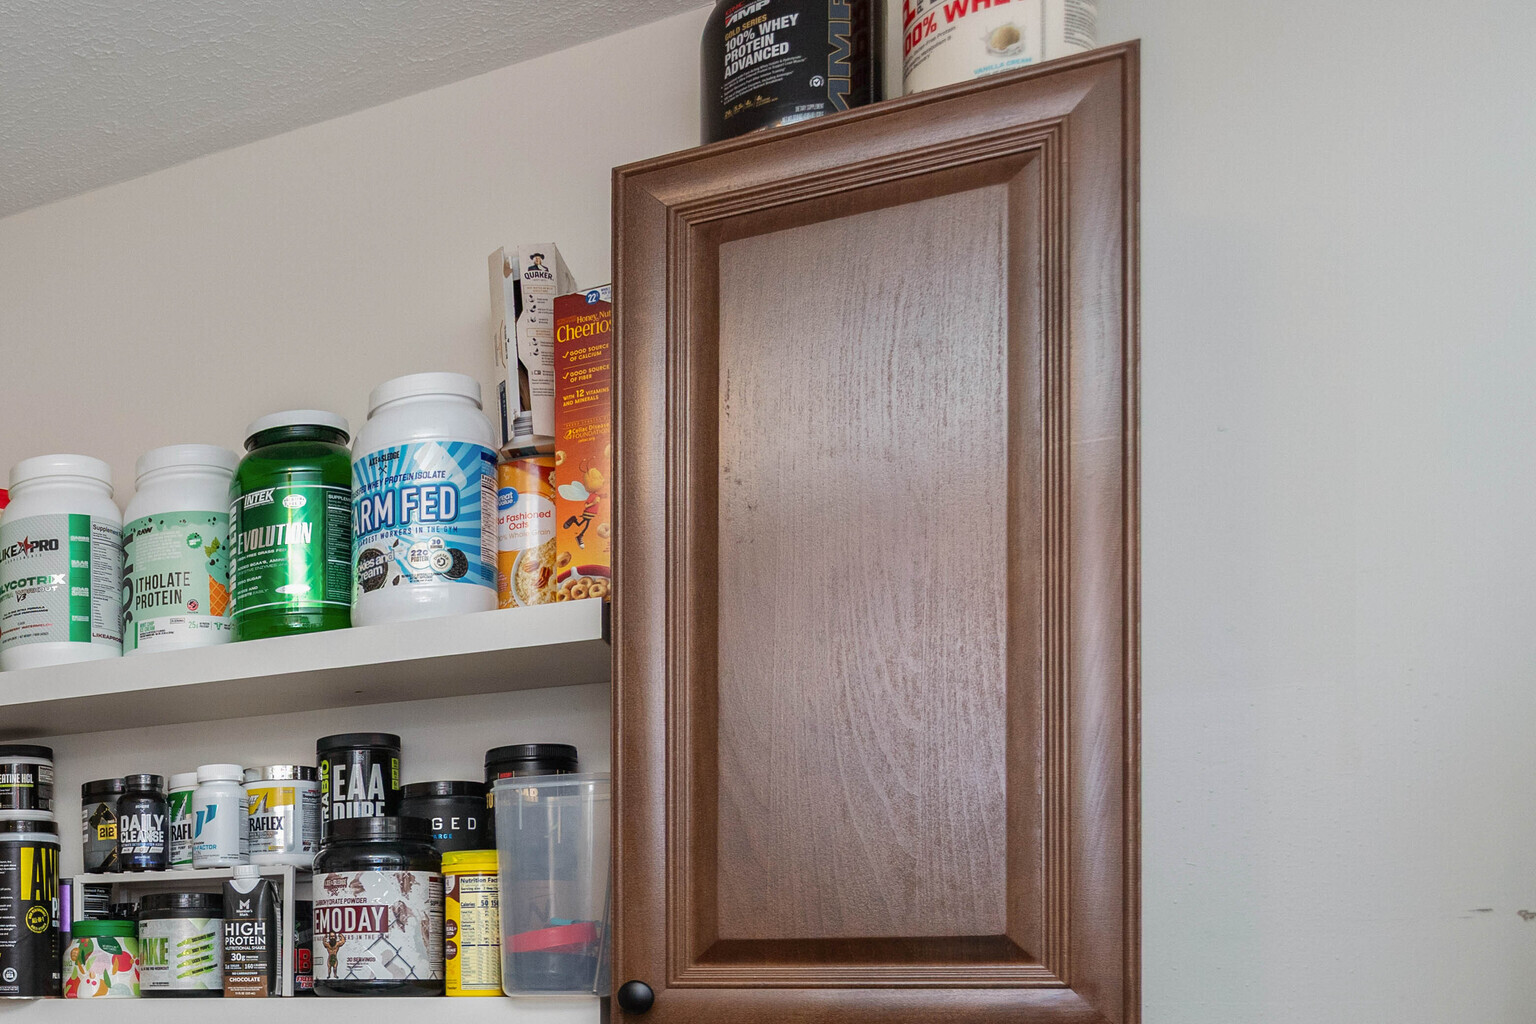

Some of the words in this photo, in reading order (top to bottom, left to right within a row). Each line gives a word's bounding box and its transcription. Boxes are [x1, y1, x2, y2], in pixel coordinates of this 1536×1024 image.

[725, 26, 740, 40] GOLD
[742, 14, 768, 30] SERIES
[725, 28, 756, 52] 100%
[758, 13, 799, 35] WHEY
[725, 33, 775, 66] PROTEIN
[724, 42, 789, 79] ADVANCED
[524, 271, 553, 280] QUAKER
[576, 312, 597, 324] Honey
[557, 320, 612, 343] Cheerio
[569, 347, 586, 356] GOOD
[588, 343, 609, 352] SOURCE
[578, 351, 602, 360] CALCIUM
[569, 369, 587, 377] GOOD
[588, 364, 610, 373] SOURCE
[578, 373, 592, 381] FIBER
[562, 393, 575, 401] WITH
[576, 389, 585, 398] 12
[586, 386, 609, 396] VITAMINS
[575, 395, 599, 404] MINERALS
[367, 479, 383, 490] WHEY
[385, 473, 414, 485] PROTEIN
[415, 470, 446, 480] ISOLATE
[244, 489, 275, 506] INTEK
[352, 488, 395, 537] ARM
[400, 485, 457, 523] FED
[506, 510, 551, 523] Fashioned
[136, 527, 153, 536] RAW
[509, 521, 529, 530] Oats
[237, 522, 312, 555] EVOLUTION
[380, 527, 412, 538] WORKERS
[136, 571, 191, 593] ITHOLATE
[16, 593, 26, 602] V3
[136, 589, 182, 610] PROTEIN
[333, 763, 385, 801] EAA
[120, 814, 164, 831] DAILY
[99, 828, 114, 837] 212
[120, 831, 164, 843] CLEANSE
[460, 876, 487, 884] Nutrition
[344, 896, 367, 904] POWDER
[225, 923, 266, 936] HIGH
[225, 937, 266, 945] PROTEIN
[231, 953, 246, 961] 30g
